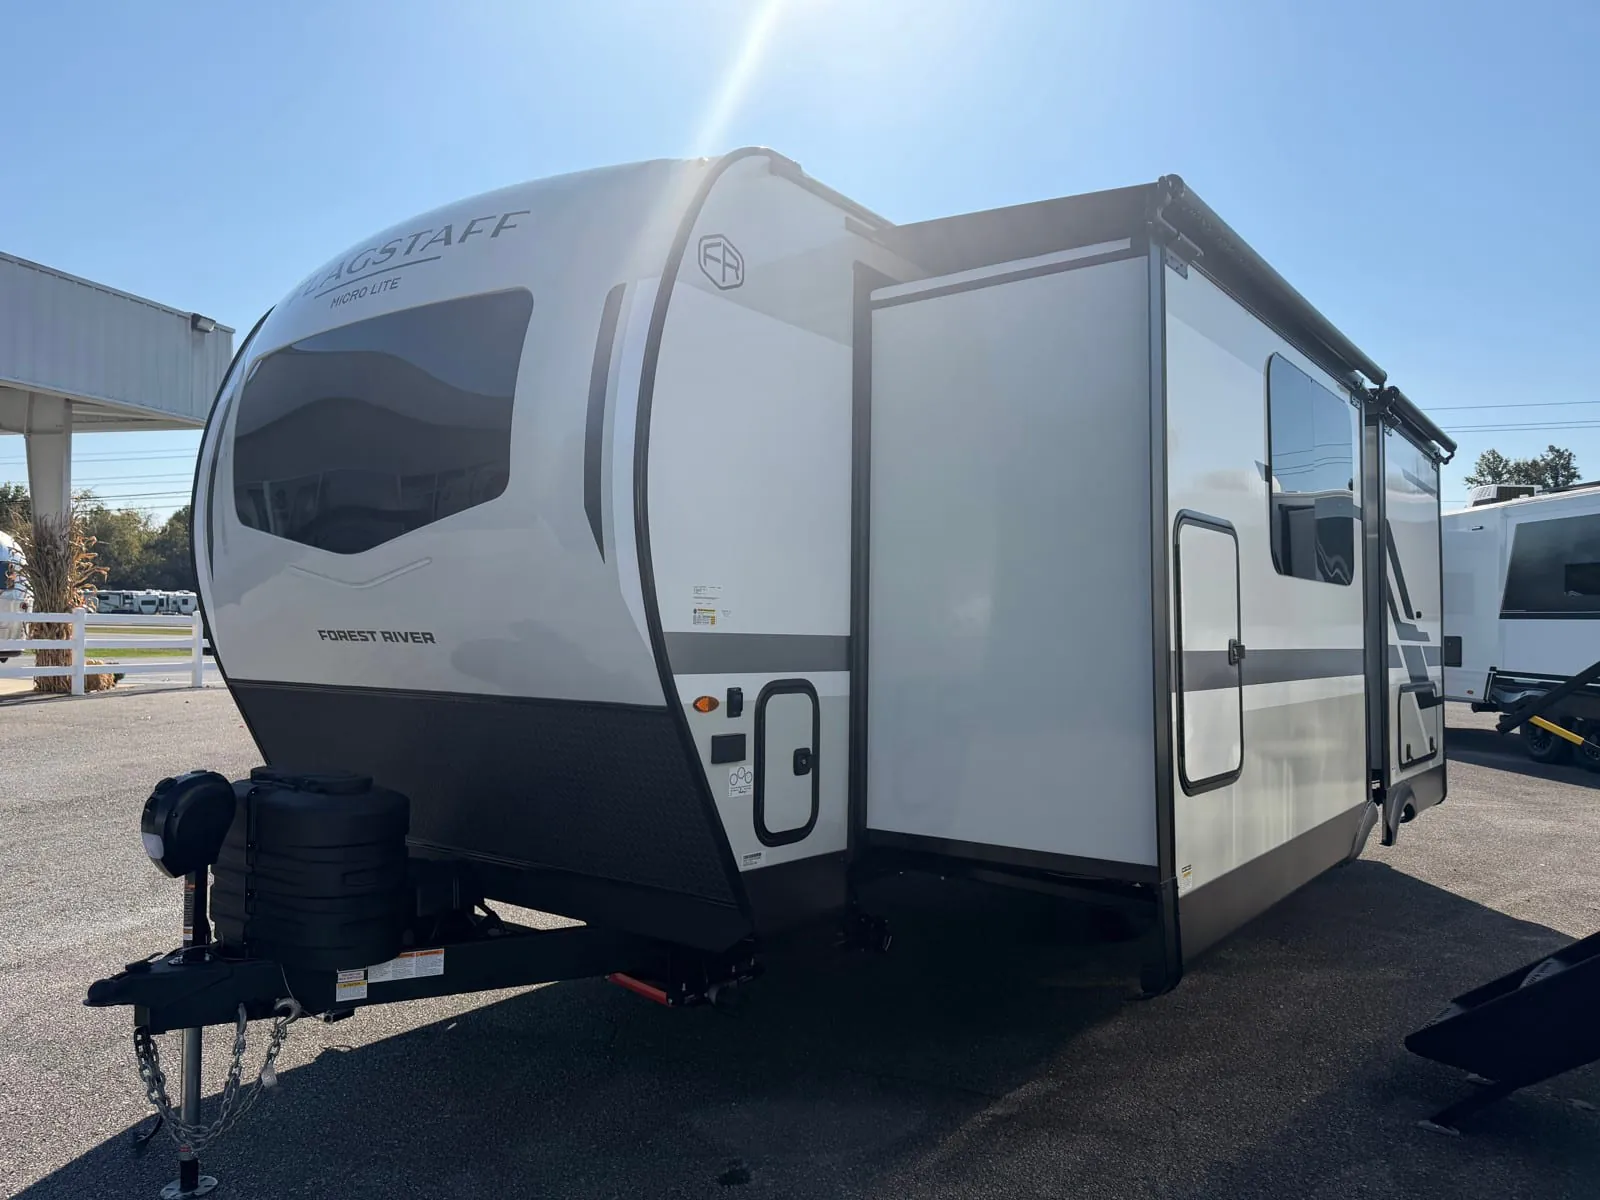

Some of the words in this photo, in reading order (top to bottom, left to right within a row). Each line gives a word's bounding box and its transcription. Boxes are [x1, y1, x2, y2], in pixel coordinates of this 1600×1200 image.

[329, 286, 367, 309] MICRO
[369, 276, 402, 296] LITE
[317, 629, 377, 642] FOREST
[379, 631, 436, 644] RIVER
